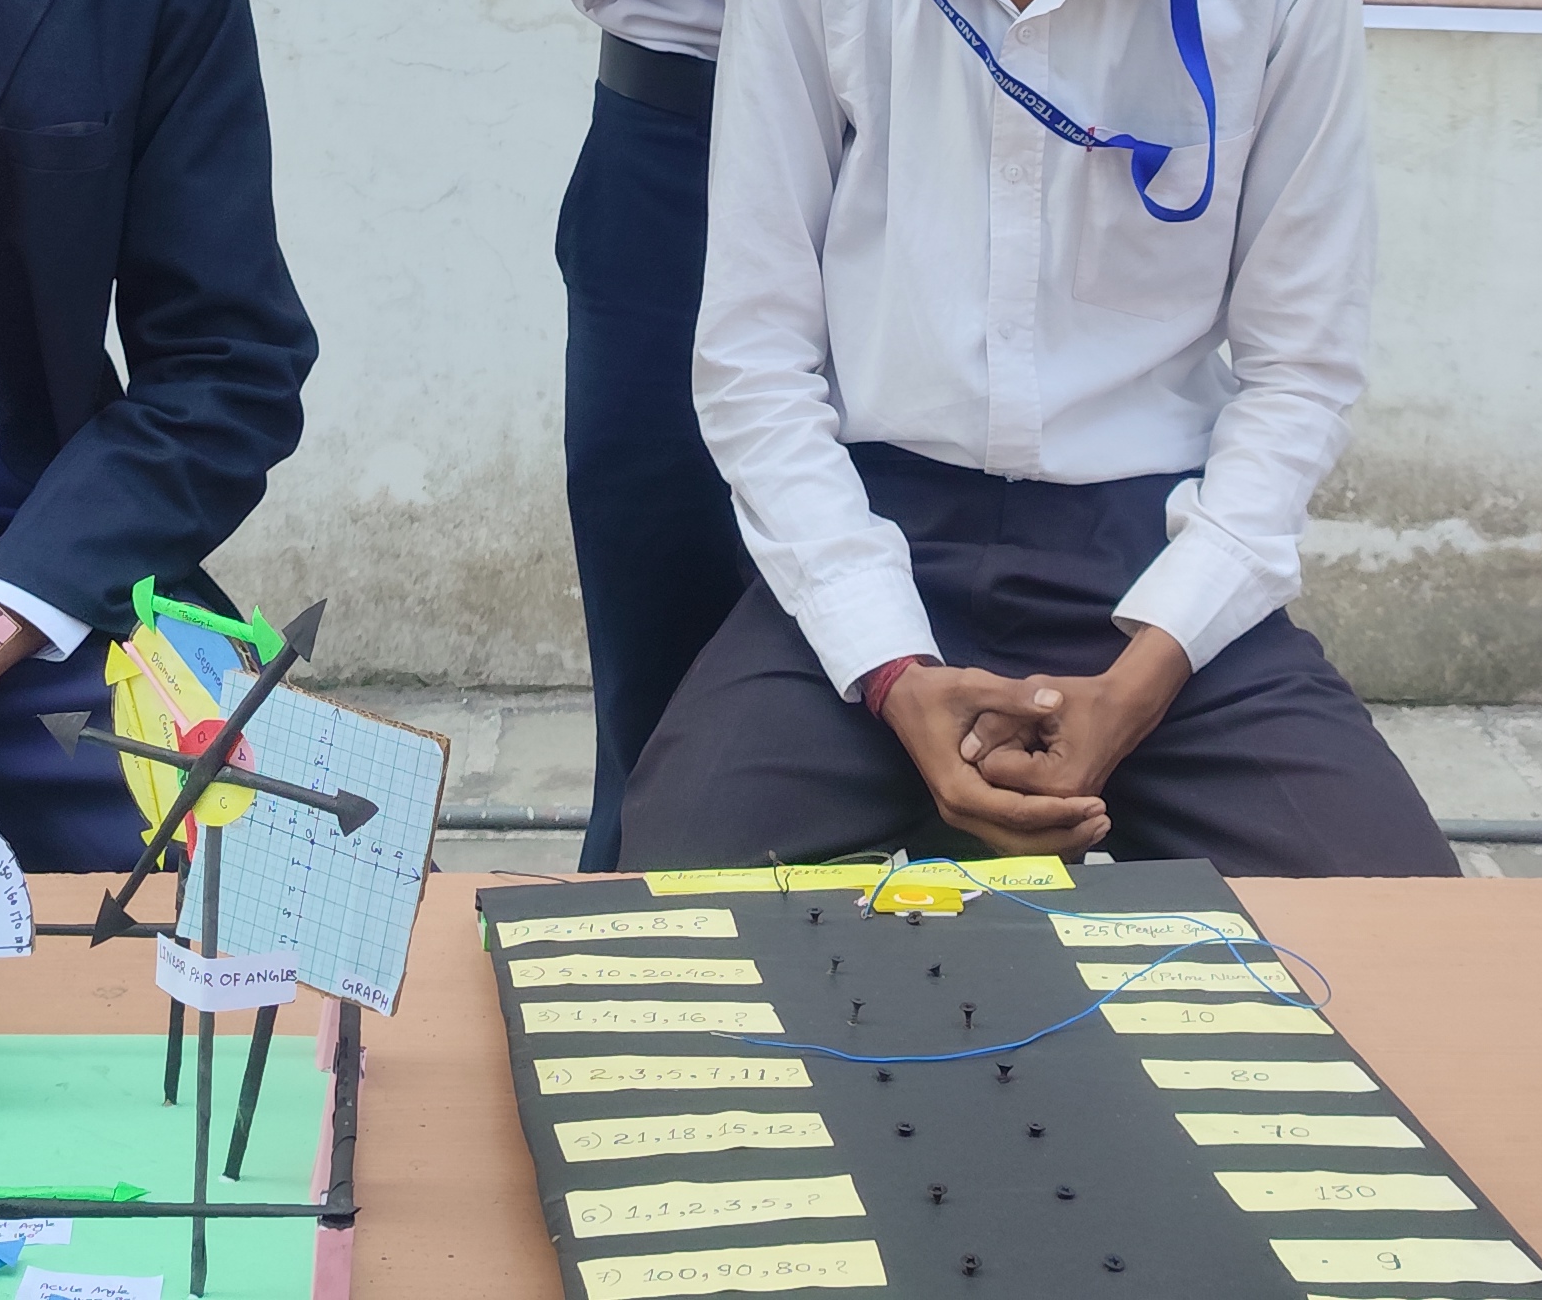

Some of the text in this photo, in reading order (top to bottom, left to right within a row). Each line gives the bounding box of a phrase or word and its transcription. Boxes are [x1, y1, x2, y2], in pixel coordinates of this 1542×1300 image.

[955, 17, 982, 48] AND
[983, 49, 1054, 121] TECHNICAL
[1054, 120, 1097, 147] RPIIT
[194, 647, 223, 688] Segmen
[3, 885, 18, 906] 160
[9, 910, 23, 930] 170
[509, 924, 530, 938] 1)
[158, 944, 298, 988] LINEAR PAIR OF ANGLES
[519, 965, 546, 980] 2)
[1210, 971, 1287, 984] Numers)
[341, 978, 390, 1010] GRAPH
[537, 1009, 560, 1023] 3)
[1181, 1009, 1216, 1025] 10
[545, 1067, 573, 1085] 4)
[1230, 1069, 1270, 1083] 80
[574, 1131, 602, 1150] 5)
[1261, 1123, 1311, 1139] 70
[1316, 1184, 1377, 1202] 130
[580, 1203, 613, 1225] 6)
[1376, 1250, 1403, 1271] 9
[596, 1268, 622, 1287] 7)
[39, 1282, 83, 1293] Acute
[90, 1284, 131, 1298] Angle
